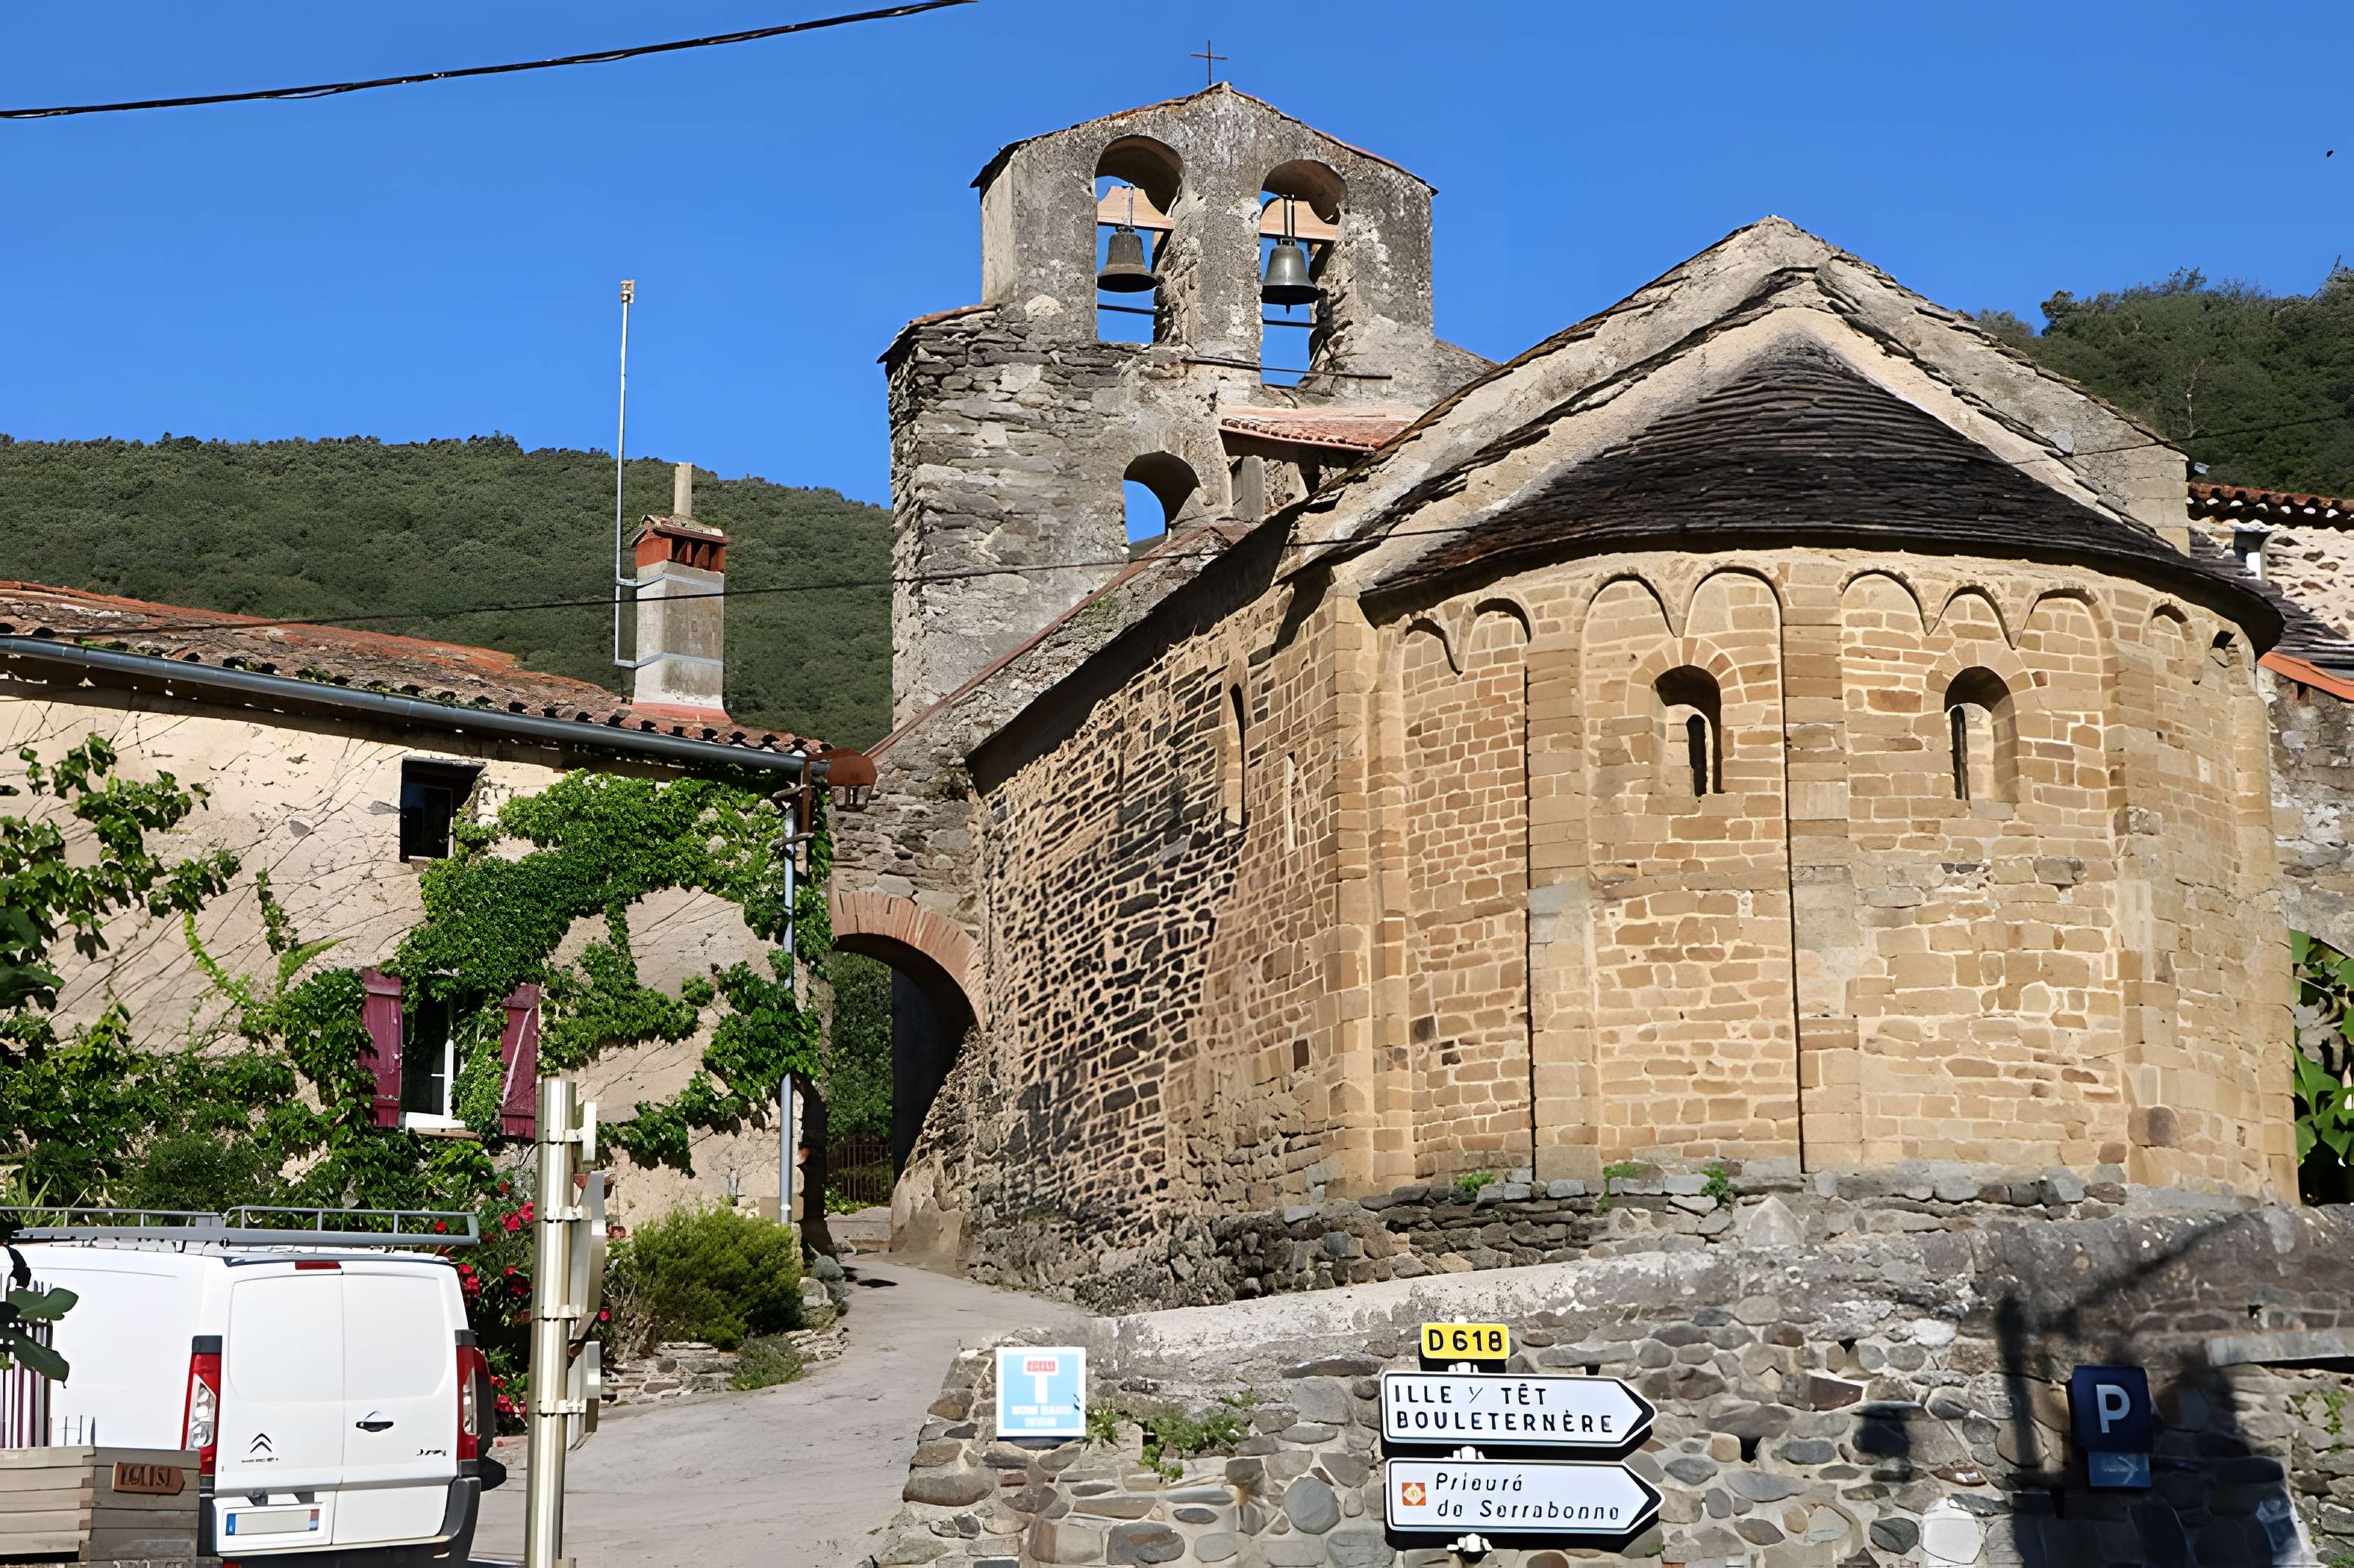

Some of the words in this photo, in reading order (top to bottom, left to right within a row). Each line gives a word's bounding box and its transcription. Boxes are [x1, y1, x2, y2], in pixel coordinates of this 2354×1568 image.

[1429, 1329, 1444, 1351] D
[1452, 1330, 1502, 1352] 618
[1394, 1384, 1452, 1403] ILLE
[1500, 1383, 1546, 1405] TÊT
[2095, 1383, 2131, 1433] P
[1396, 1410, 1613, 1433] BOULETERNÈRE
